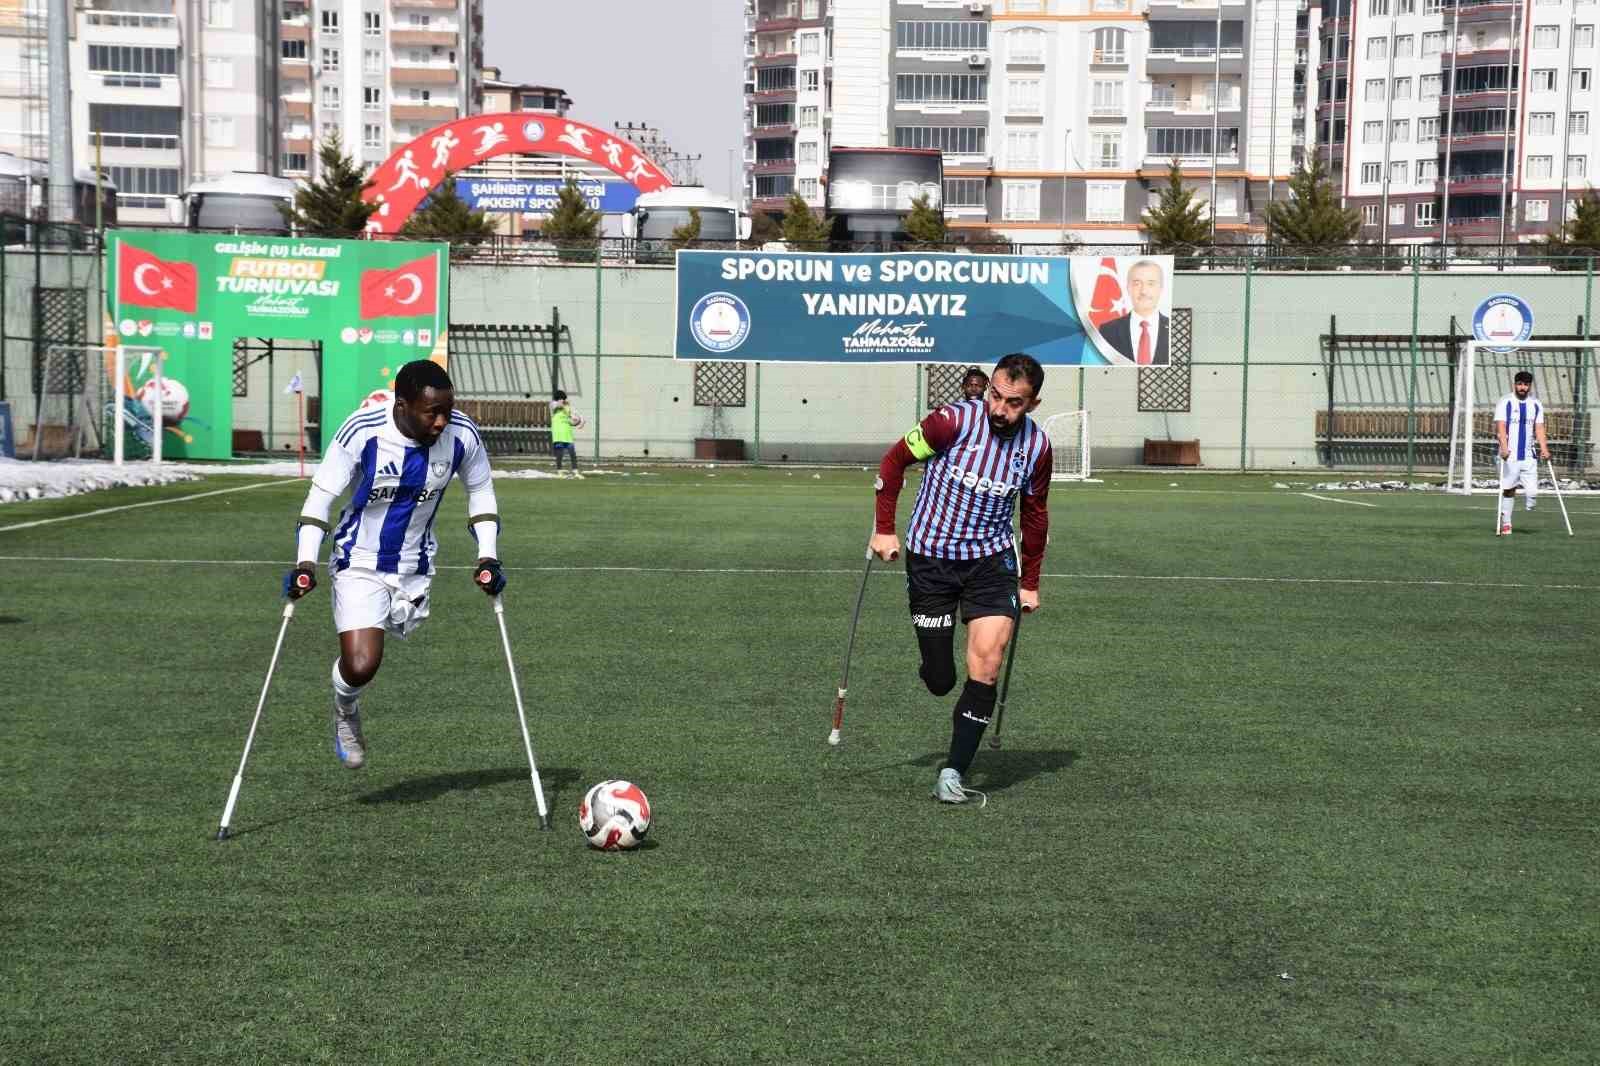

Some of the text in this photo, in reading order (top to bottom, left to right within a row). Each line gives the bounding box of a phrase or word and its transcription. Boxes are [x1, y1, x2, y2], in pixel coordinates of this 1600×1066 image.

[471, 182, 606, 197] ŞAHİNBEY BELYESİ
[236, 259, 318, 278] FUTBOL
[721, 258, 1049, 284] SPORUN ve SPORCUNUN
[216, 276, 340, 296] TURNUVASI
[803, 293, 968, 316] YANINDAYIZ
[852, 318, 928, 338] Mehmet
[842, 335, 935, 348] TAHMAZOĞLU
